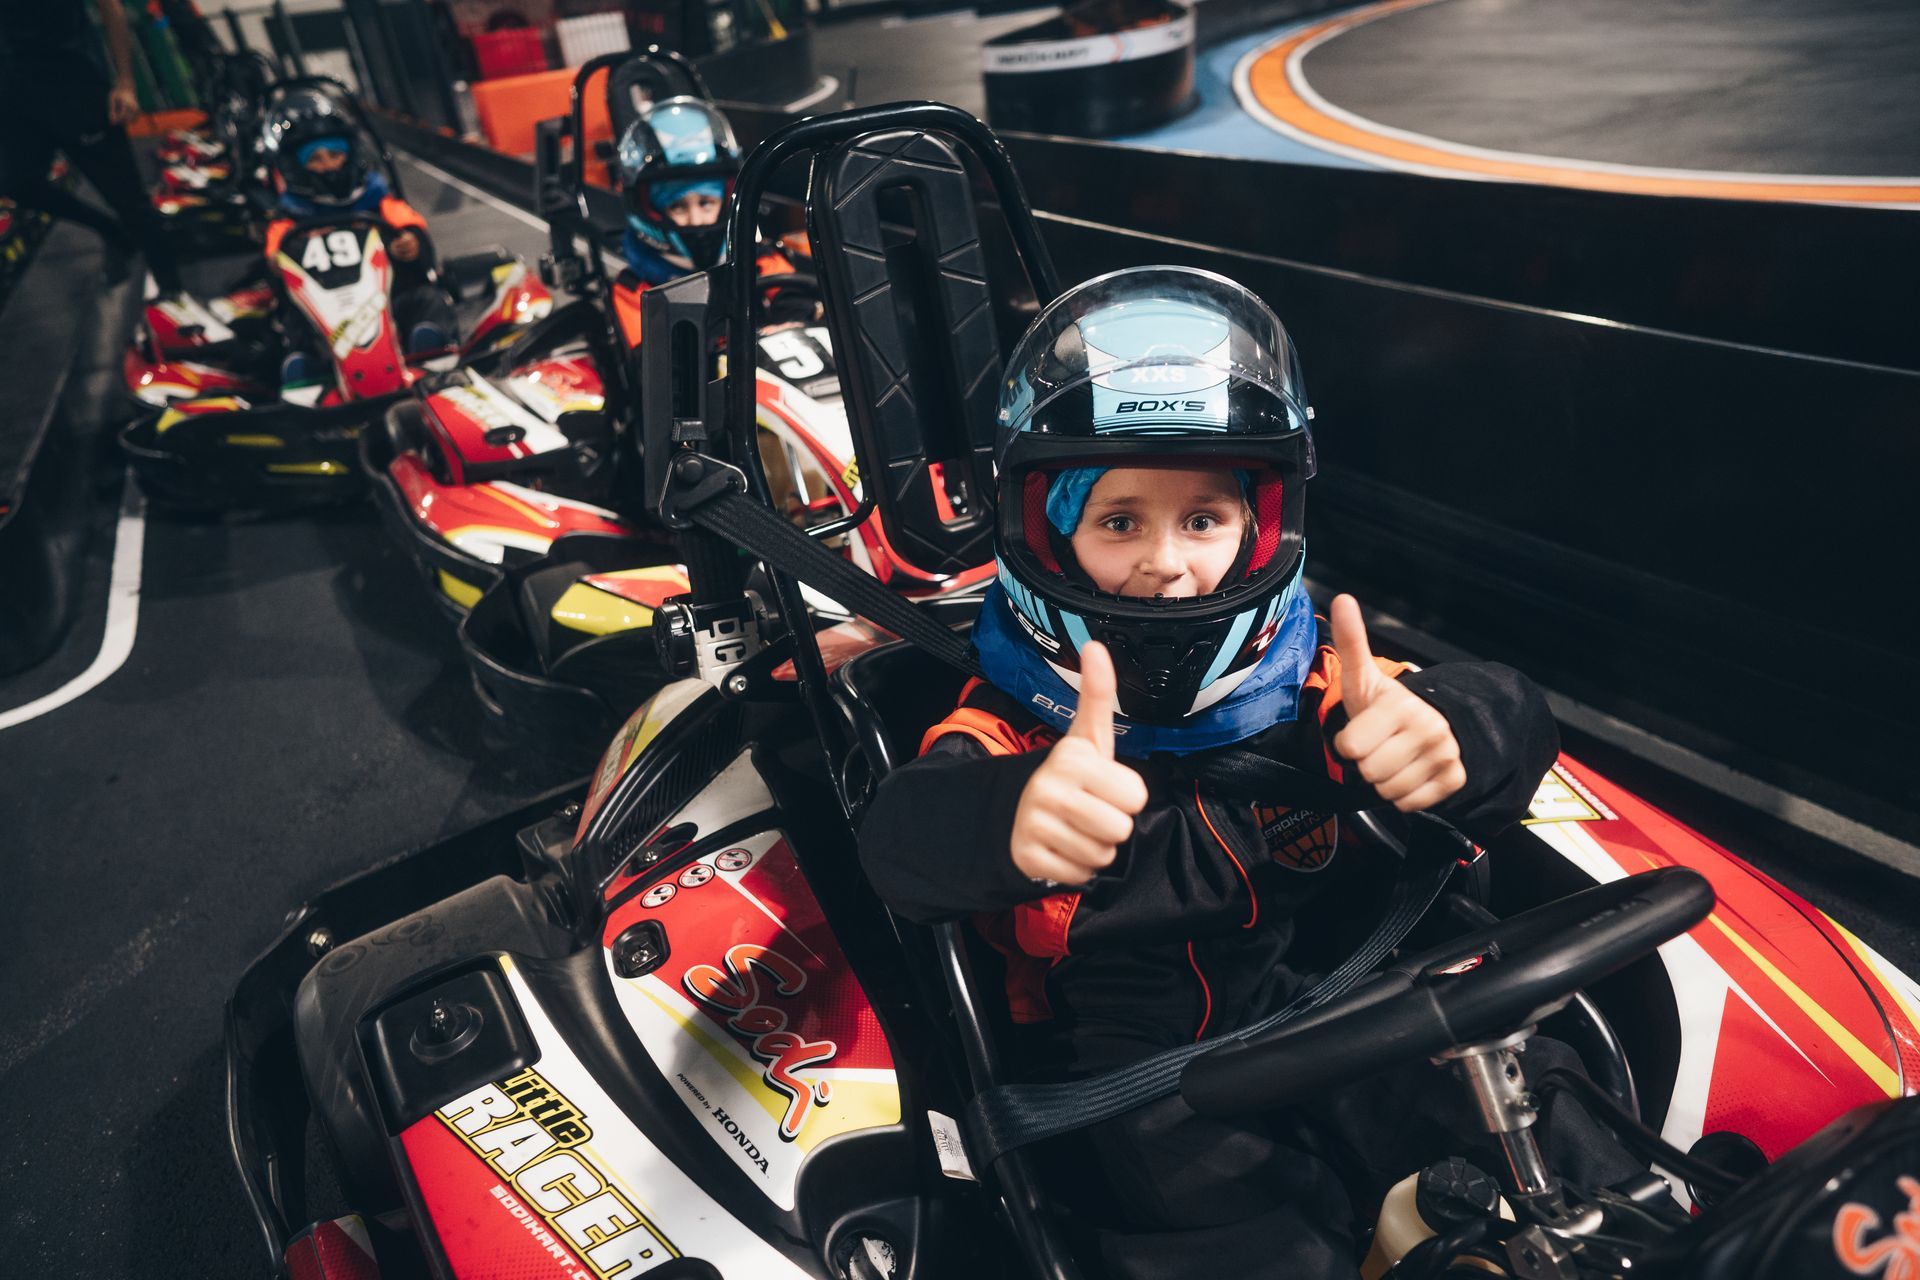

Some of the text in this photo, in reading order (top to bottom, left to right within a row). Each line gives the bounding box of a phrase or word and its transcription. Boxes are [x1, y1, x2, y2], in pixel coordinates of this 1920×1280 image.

[301, 230, 363, 272] 49
[1116, 400, 1206, 414] BOX'S
[1032, 693, 1132, 735] BOS
[495, 1068, 590, 1146] Little
[676, 1073, 705, 1102] POWERED
[711, 1107, 769, 1175] HONDA
